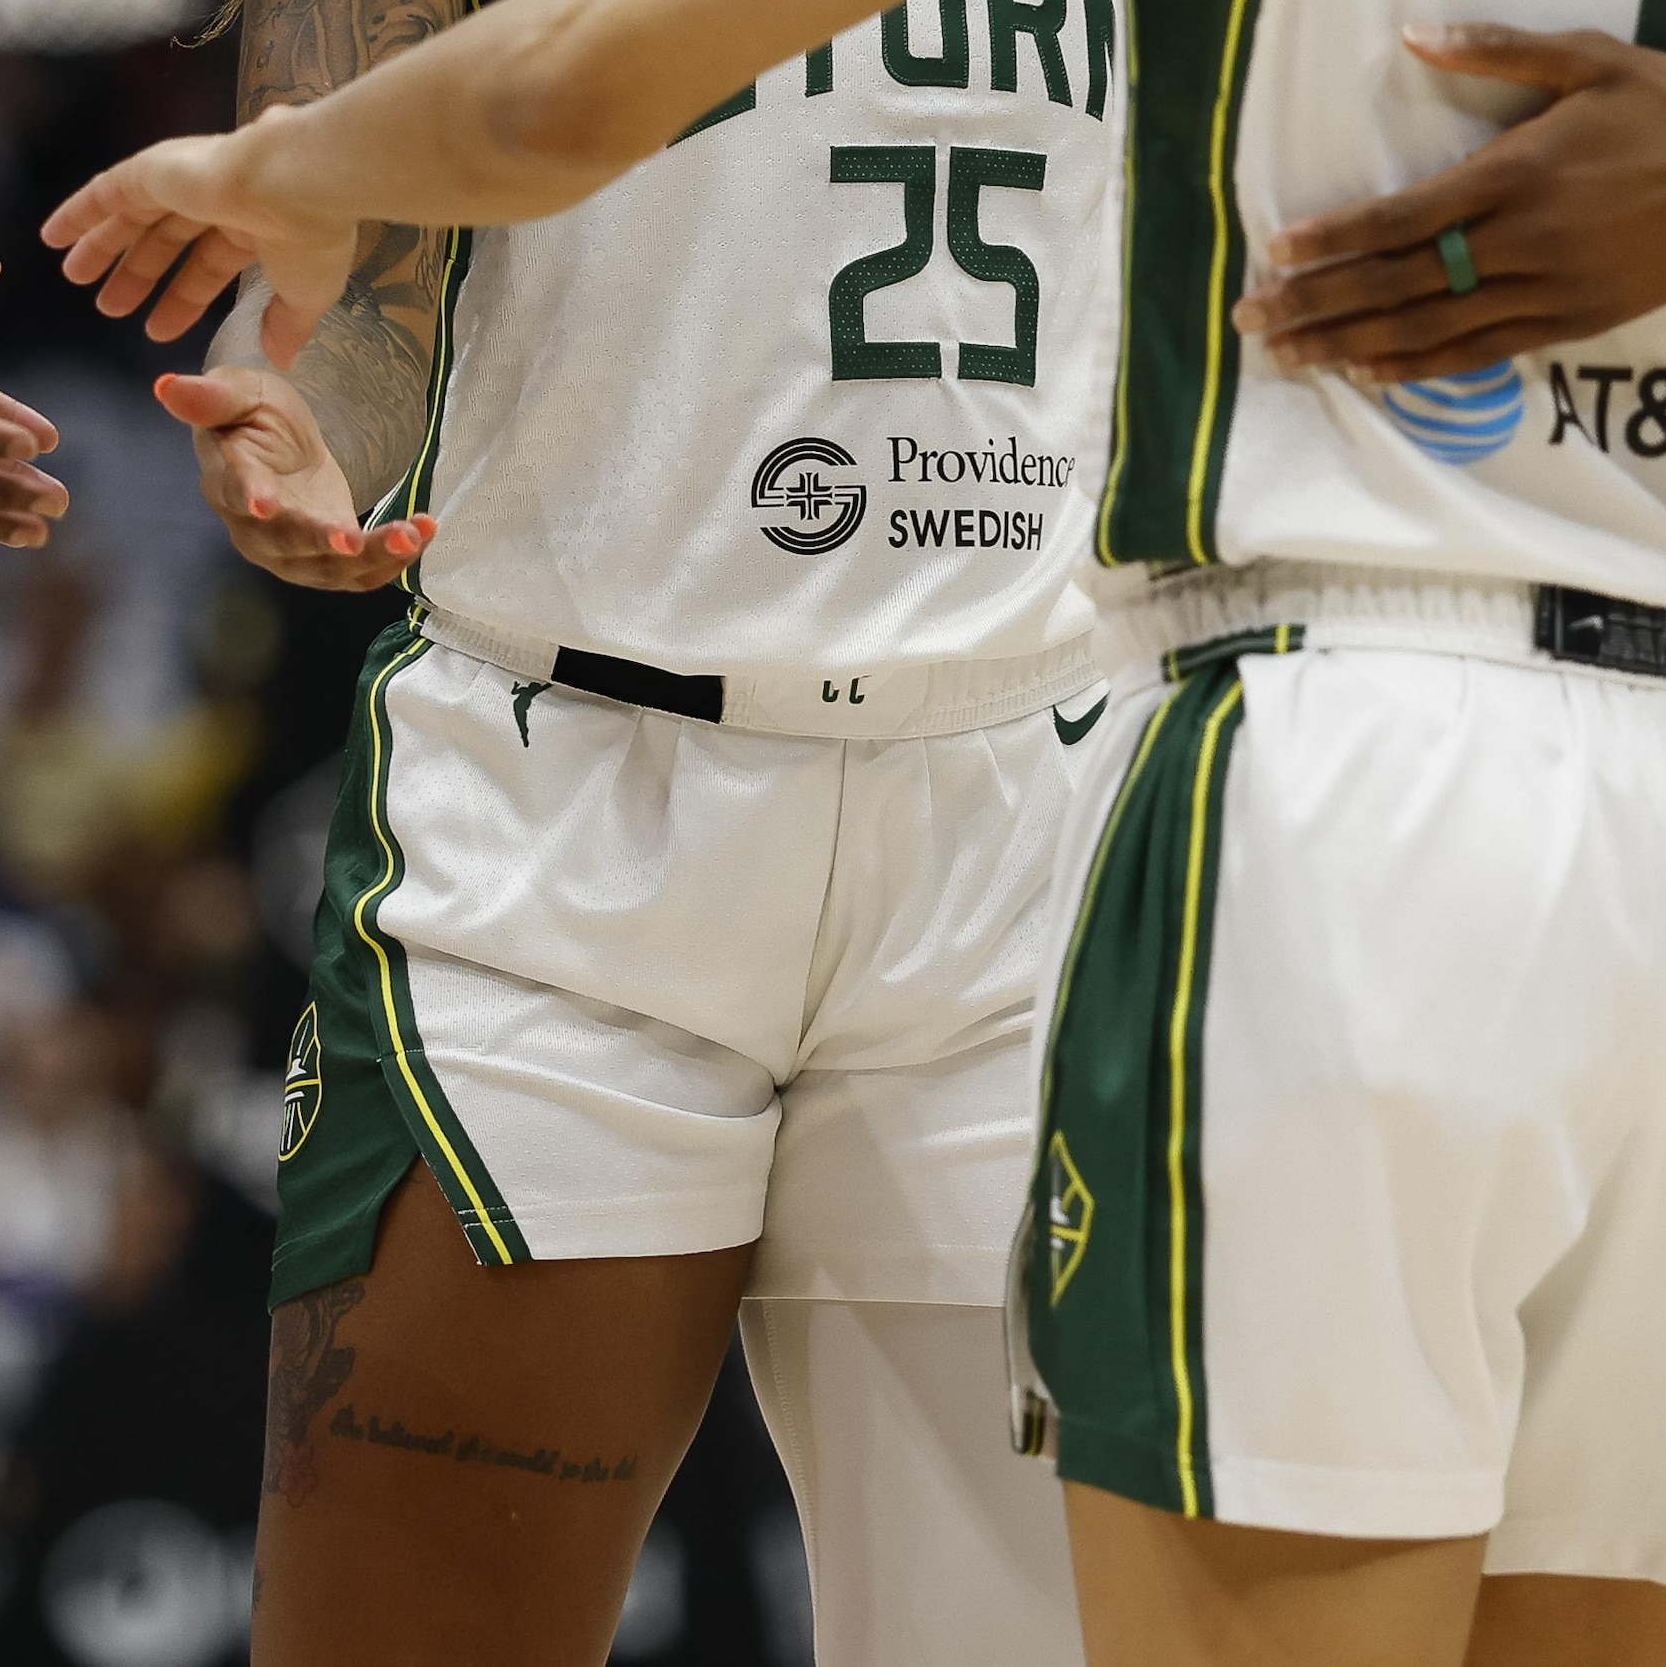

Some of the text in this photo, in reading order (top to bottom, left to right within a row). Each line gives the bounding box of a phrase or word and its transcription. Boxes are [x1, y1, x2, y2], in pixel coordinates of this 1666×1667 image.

[828, 144, 1048, 389] 25
[886, 435, 1076, 489] Providence
[887, 508, 1044, 552] SWEDISH
